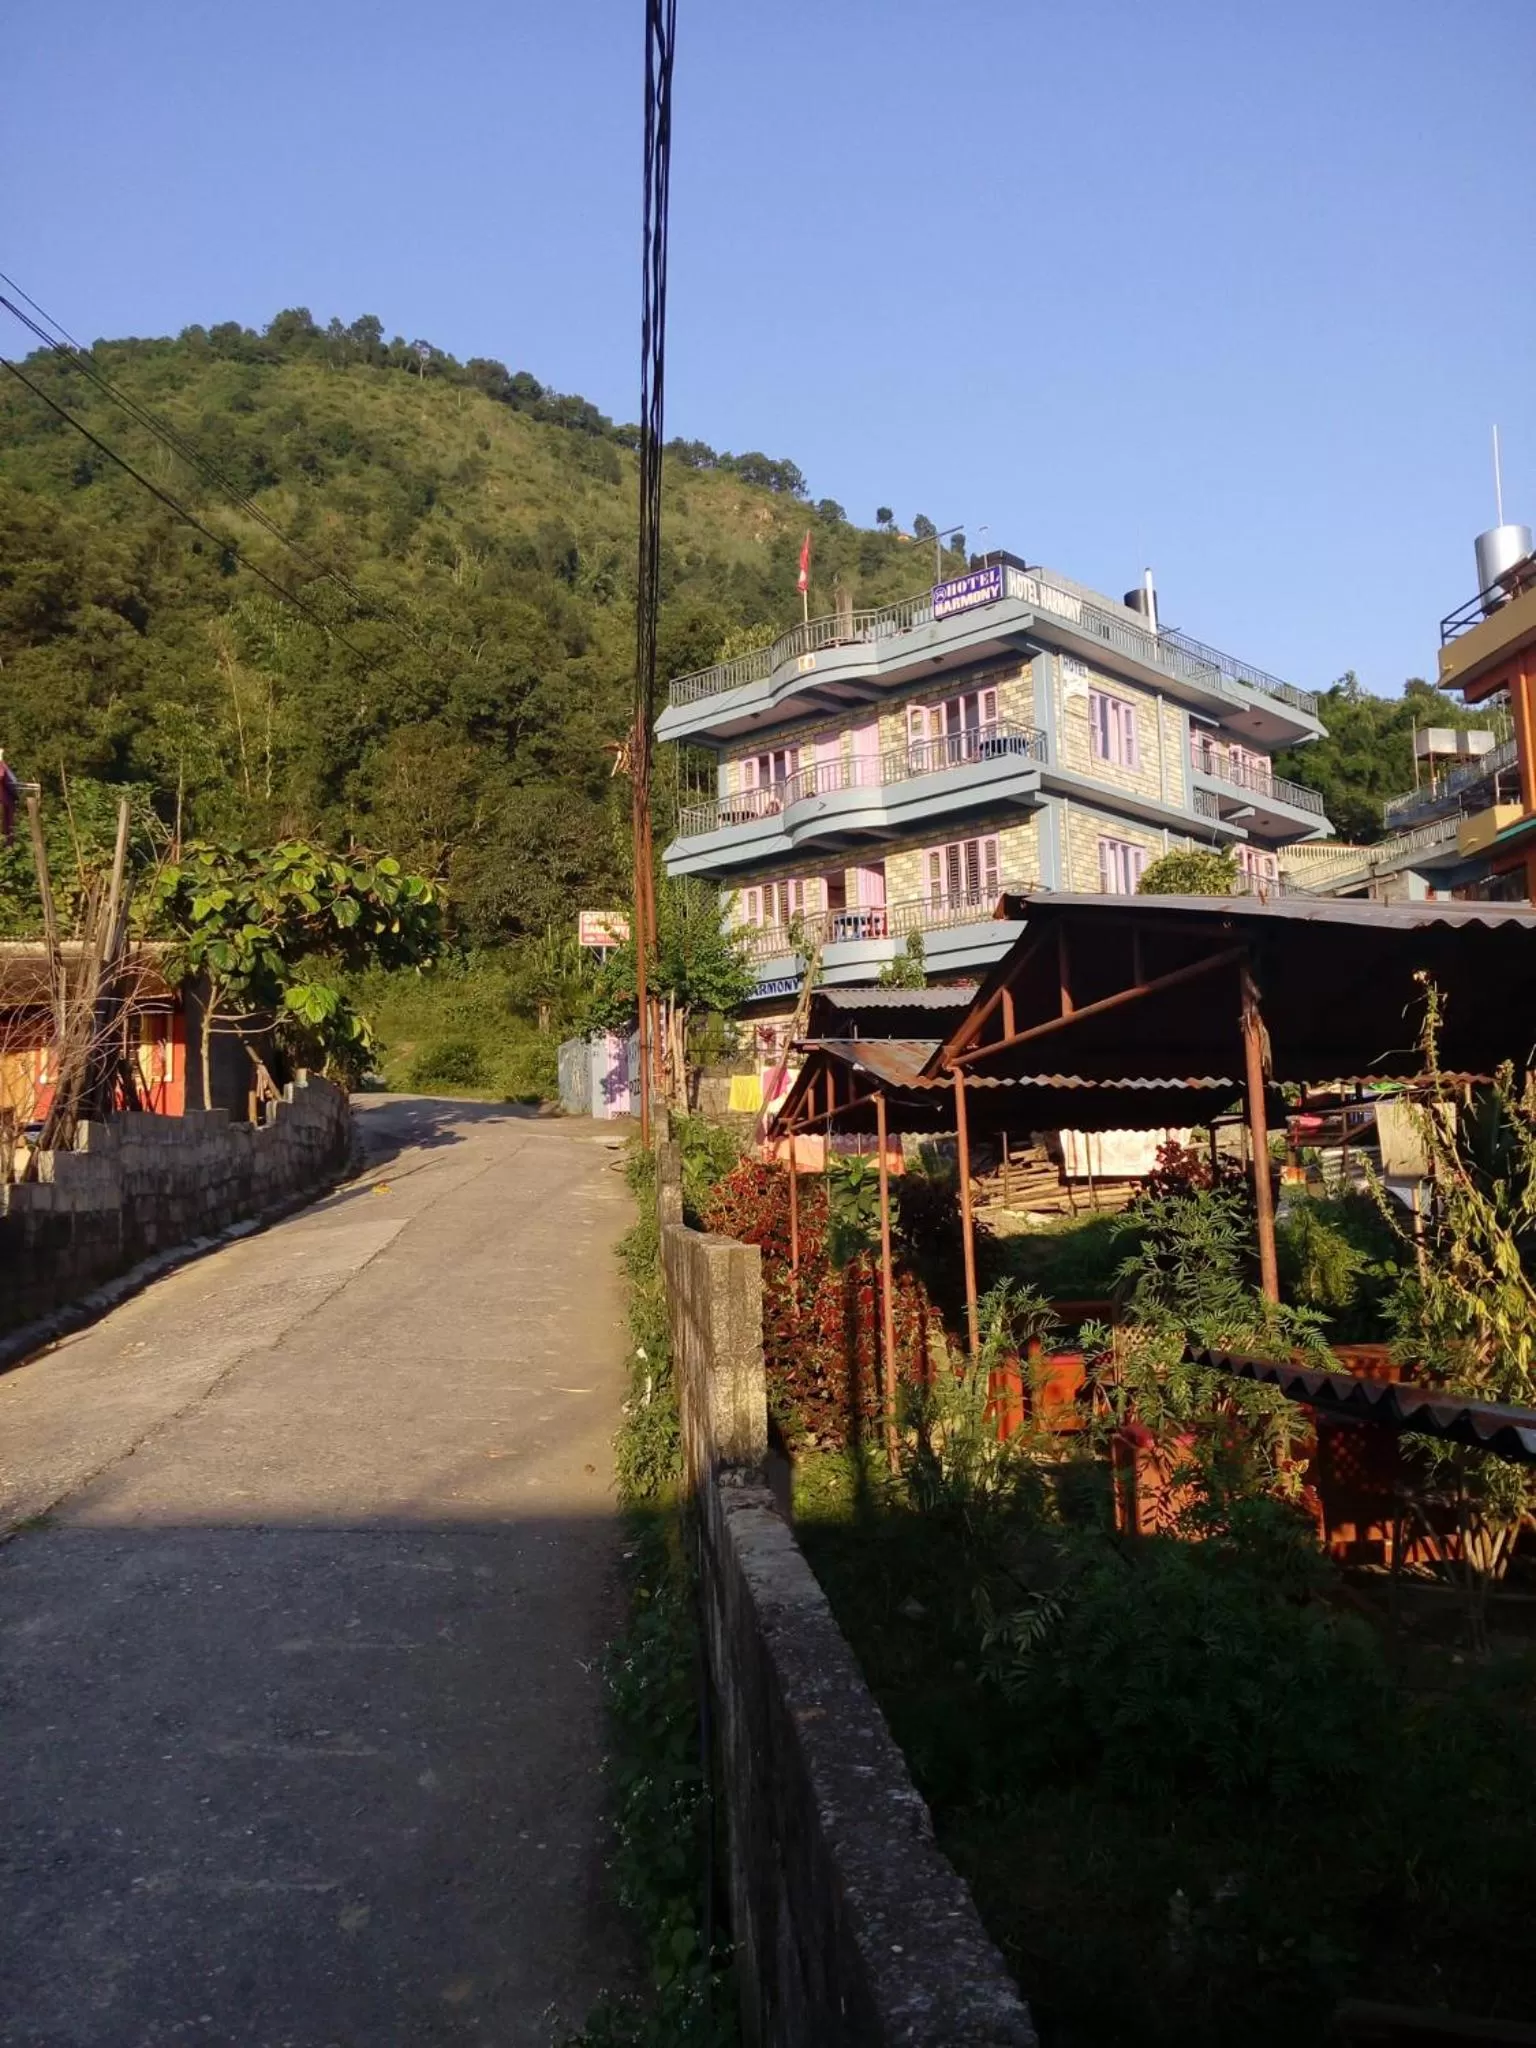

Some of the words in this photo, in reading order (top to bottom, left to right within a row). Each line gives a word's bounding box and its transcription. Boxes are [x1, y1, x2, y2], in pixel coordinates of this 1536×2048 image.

[946, 569, 999, 597] HOTEL
[1010, 570, 1039, 604] HOTEL
[1040, 584, 1081, 624] HARMONY
[935, 584, 999, 616] HARMONY
[1063, 657, 1088, 678] HOTEL
[752, 978, 799, 996] ARMONY
